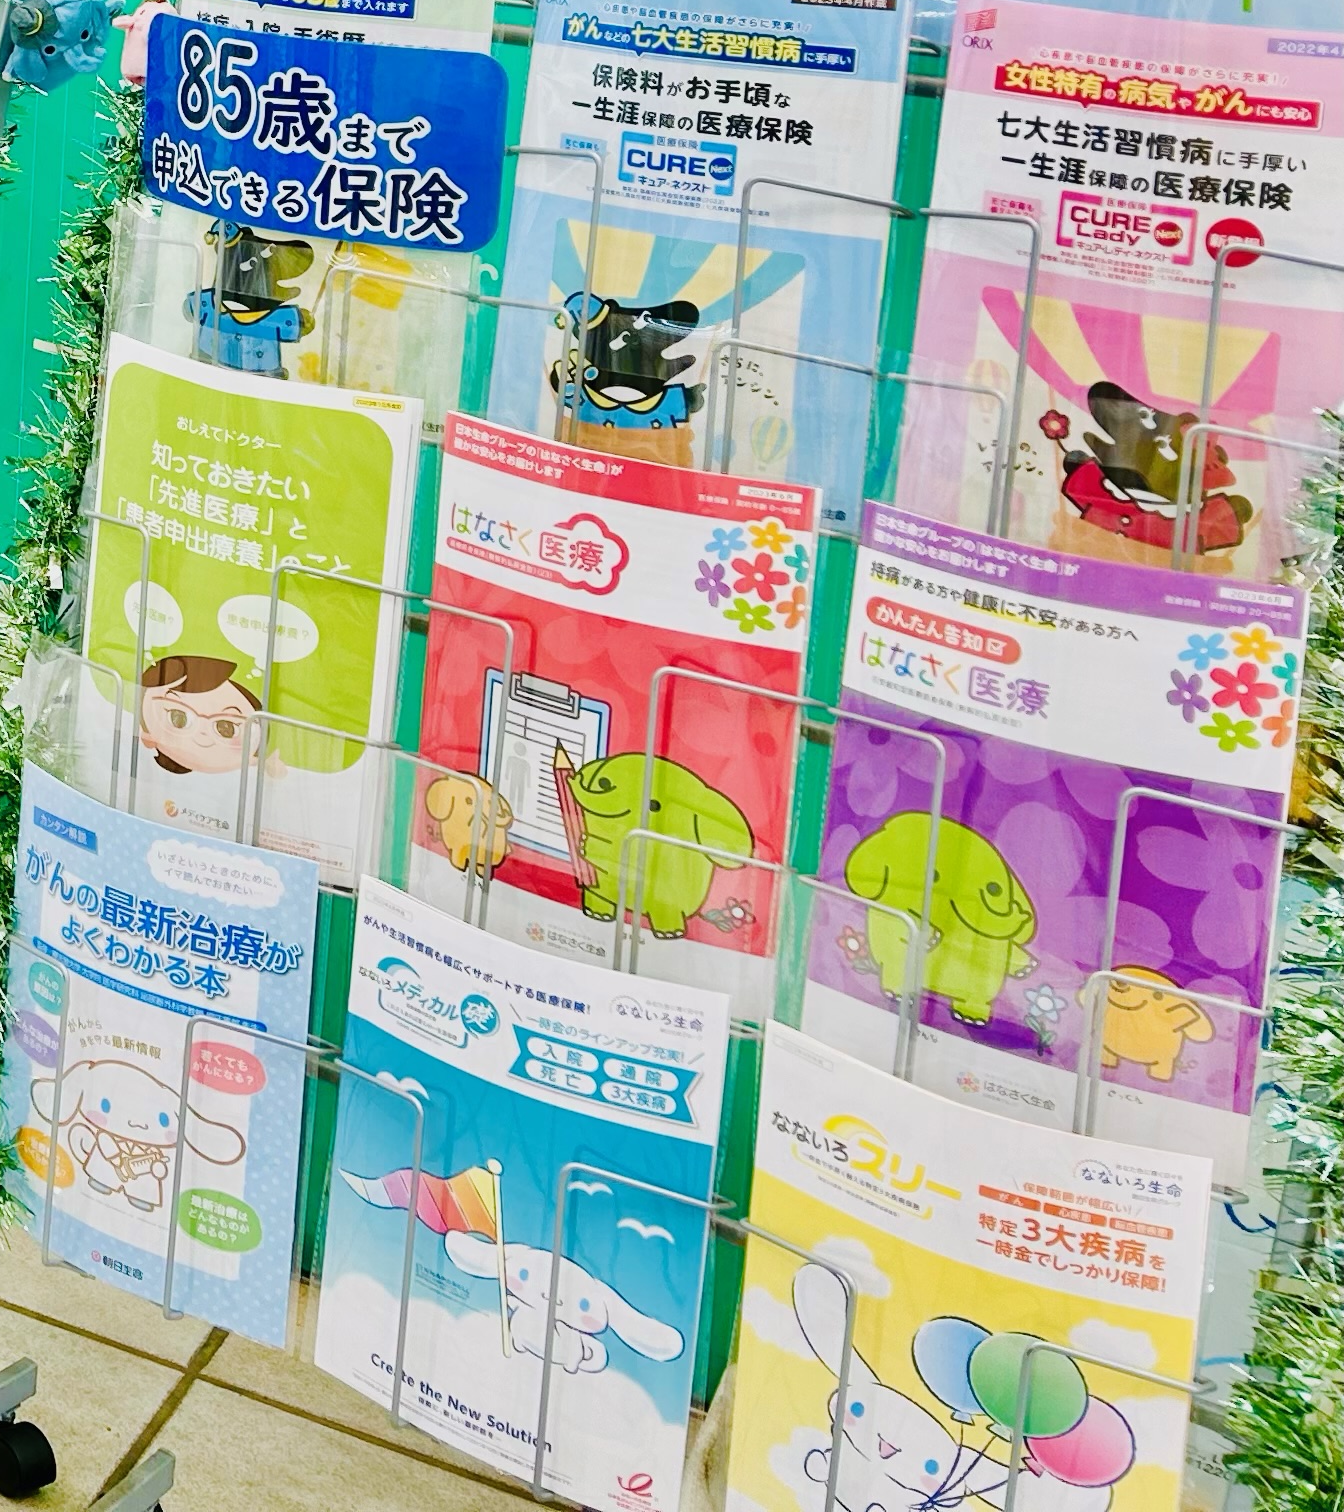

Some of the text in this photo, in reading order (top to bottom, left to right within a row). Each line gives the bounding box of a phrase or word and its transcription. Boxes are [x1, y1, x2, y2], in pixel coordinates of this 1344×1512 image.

[565, 13, 852, 67] がんなどの七大生活習慣病に手厚い
[179, 32, 429, 160] 85歳まで
[592, 63, 791, 110] 保険料がお手頃な
[1004, 62, 1312, 122] 女性特有の病気やがんにも安心
[571, 97, 814, 146] 一生涯保障の医療保険
[996, 111, 1307, 173] 七大生活習慣病に手厚い
[153, 134, 466, 241] 申込できる保険
[625, 148, 707, 176] CURE
[1001, 153, 1294, 212] 一生涯保障の医療保険
[1070, 207, 1152, 233] CURE
[1076, 224, 1142, 247] Lady
[177, 416, 282, 450] おしえてドクター
[455, 423, 624, 477] 日本生命グループの「はなさく生命」が
[151, 439, 311, 501] 知っておきたい
[149, 474, 308, 540] 「先進医療」と
[451, 502, 605, 575] はなさく医療
[875, 512, 1080, 577] 日本生命グループの「はなさく生命」が
[870, 559, 1140, 642] 持病がある方や健康に不安がある方へ
[875, 602, 983, 653] かんたん告知
[860, 631, 1051, 721] はなさく医療
[24, 844, 303, 974] がんの最新治療が
[60, 914, 231, 1000] よくわかる本
[617, 1002, 705, 1032] なないろ生命
[540, 1066, 580, 1089] 死亡
[542, 1041, 583, 1067] 入院
[771, 1110, 964, 1202] なないろスリー
[1080, 1165, 1183, 1199] なないろ生命
[975, 1239, 1167, 1294] 一時金でしっかり保障!
[978, 1213, 1166, 1272] 特定3大疾病を
[370, 1352, 415, 1388] Crete
[419, 1379, 443, 1403] the
[447, 1394, 482, 1421] New
